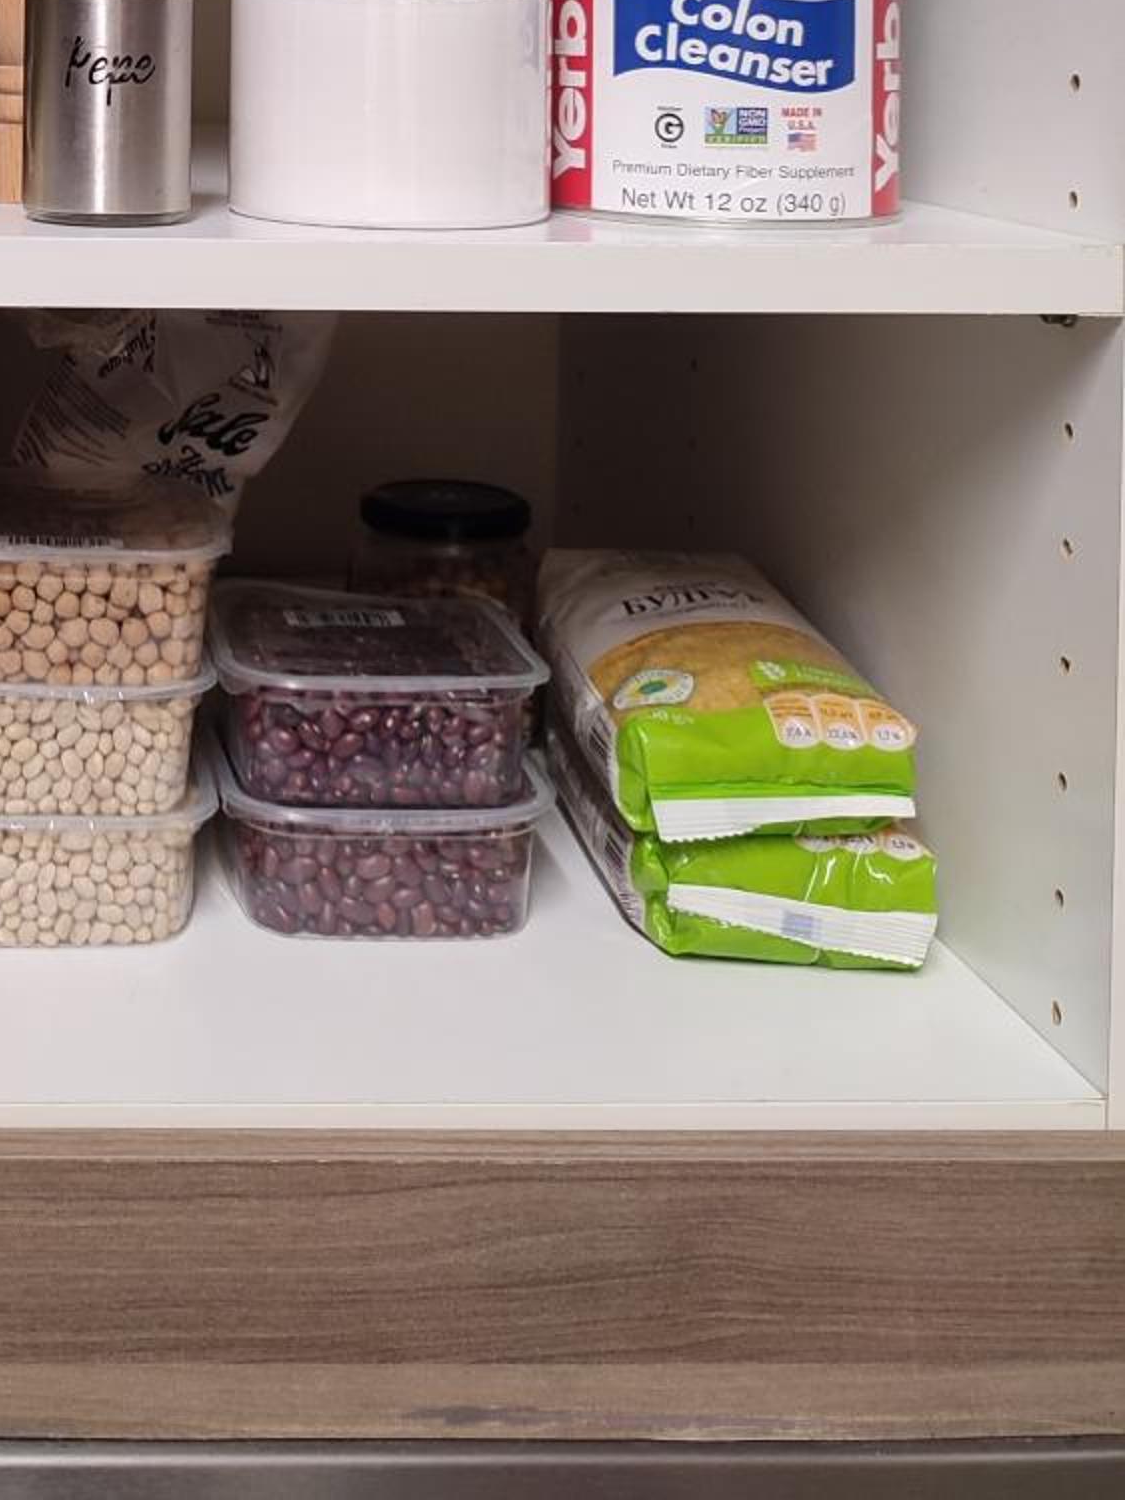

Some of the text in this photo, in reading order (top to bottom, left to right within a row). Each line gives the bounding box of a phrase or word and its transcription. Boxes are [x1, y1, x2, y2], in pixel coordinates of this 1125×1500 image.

[634, 23, 834, 88] Cleanser
[781, 107, 823, 118] MADE IN
[612, 159, 855, 180] Premium Dietary Fiber Supplement
[621, 187, 847, 216] Net Wt 12 oz (340 g)
